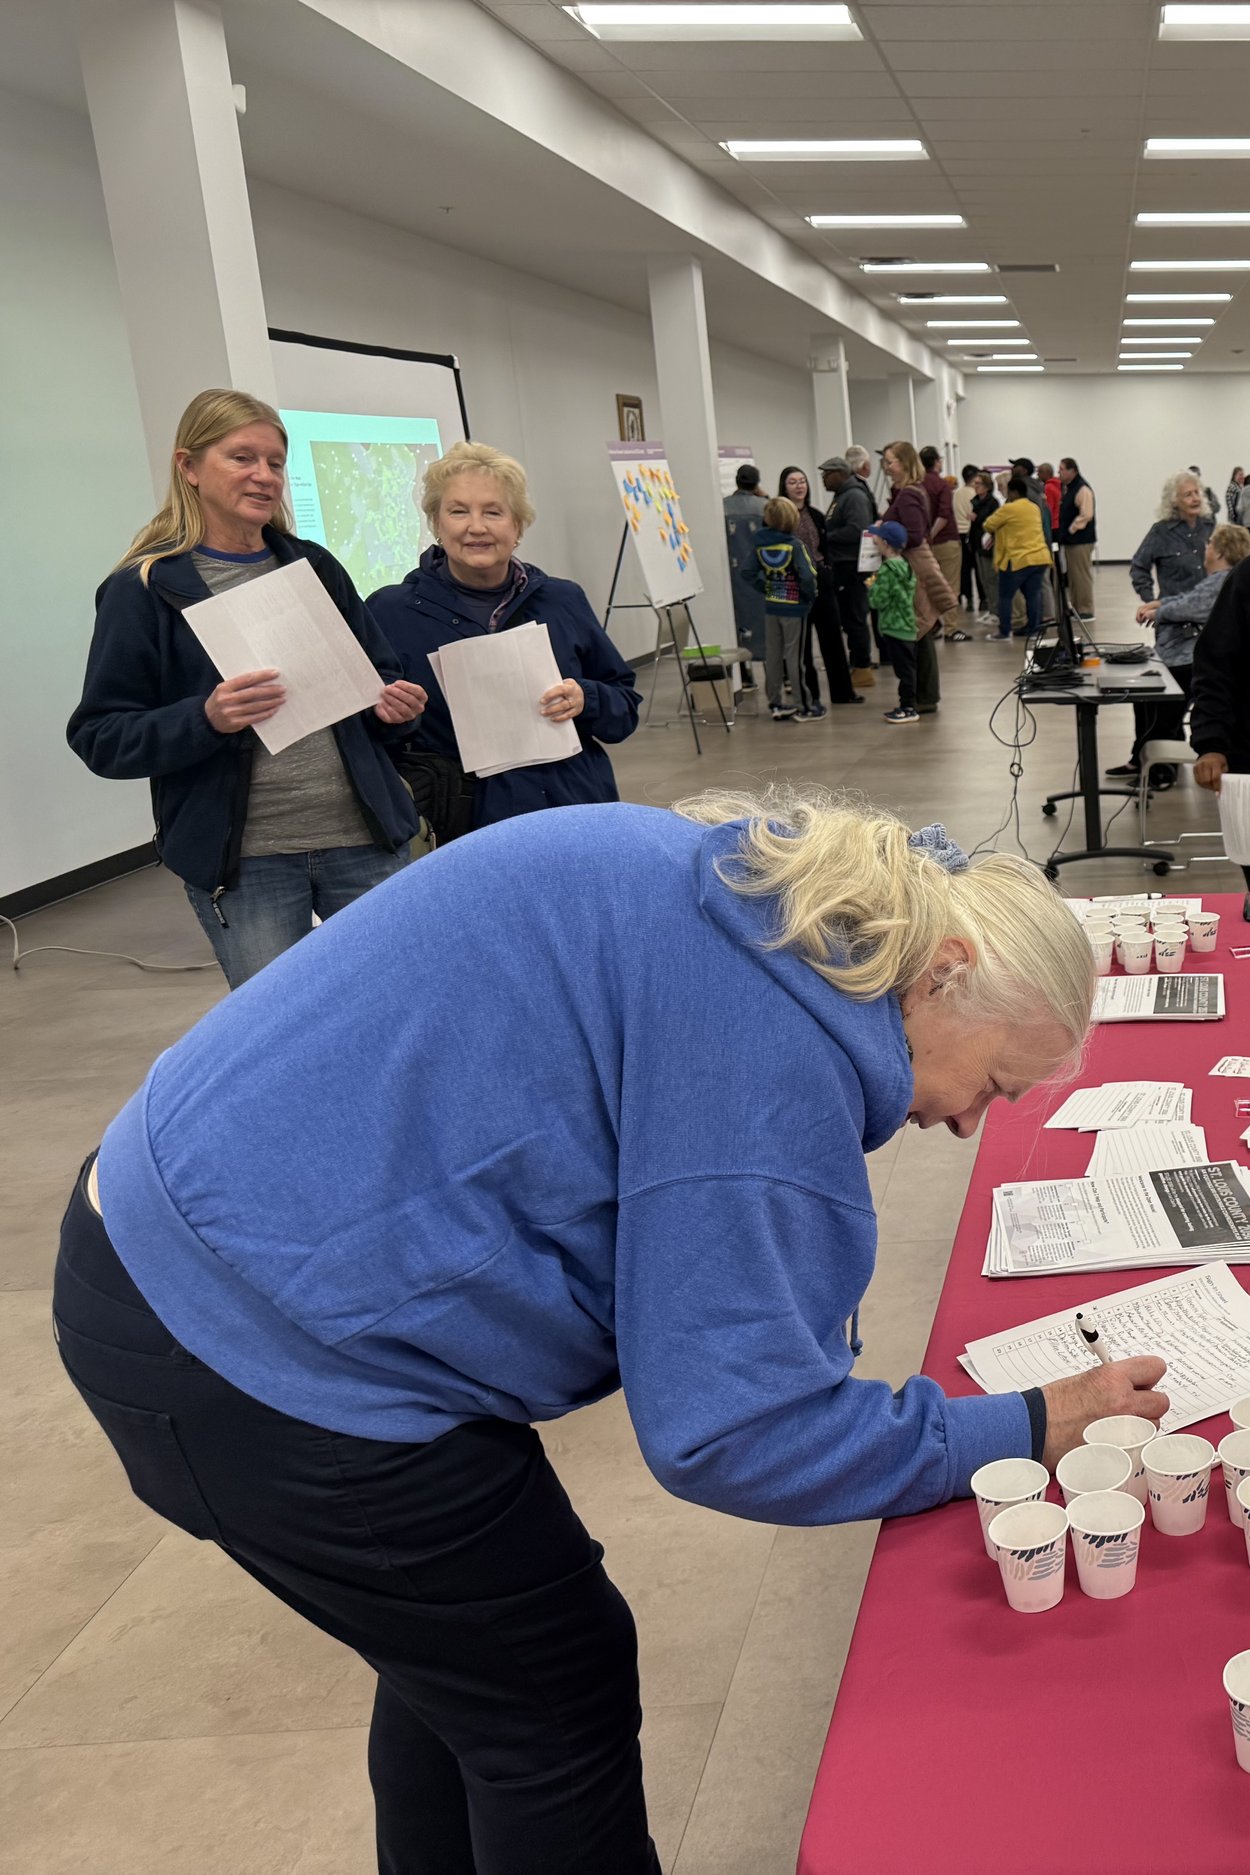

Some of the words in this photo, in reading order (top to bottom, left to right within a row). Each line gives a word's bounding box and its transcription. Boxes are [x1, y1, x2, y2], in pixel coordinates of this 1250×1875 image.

[1205, 1166, 1224, 1178] ST.
[1212, 1178, 1234, 1196] LOUIS
[1221, 1195, 1249, 1224] COUNTY
